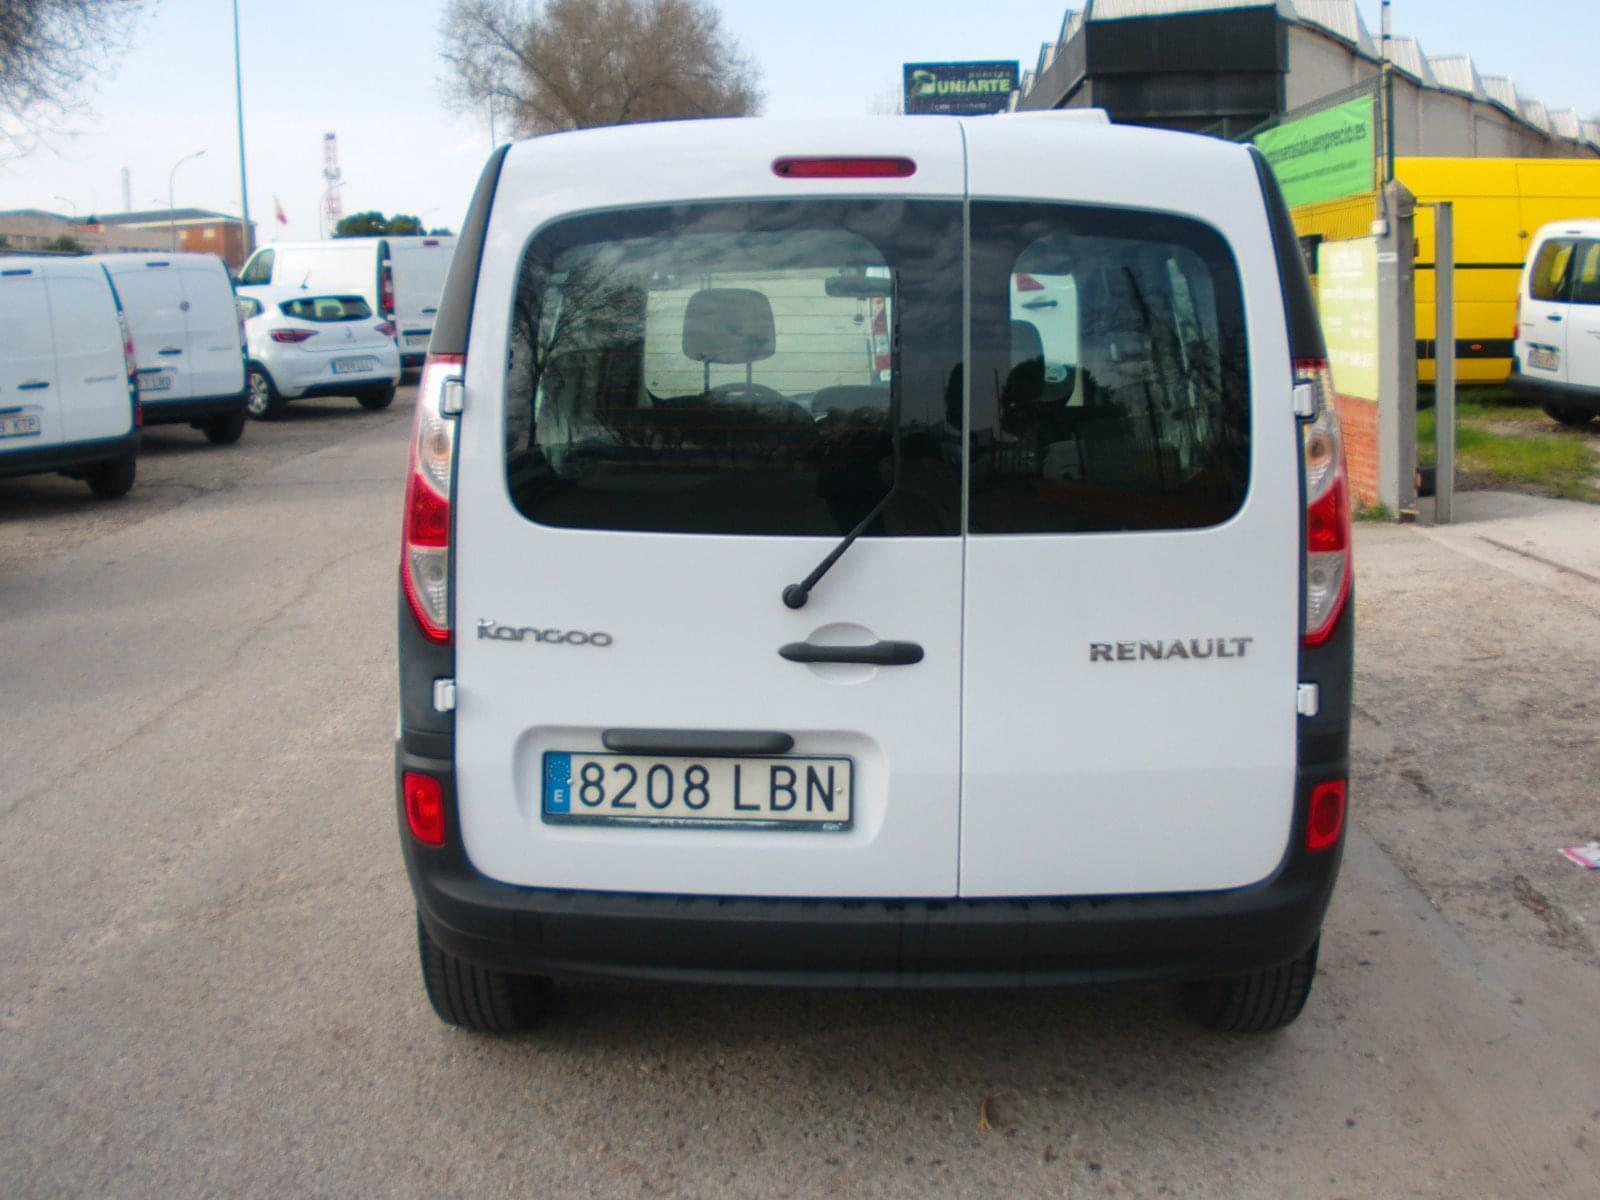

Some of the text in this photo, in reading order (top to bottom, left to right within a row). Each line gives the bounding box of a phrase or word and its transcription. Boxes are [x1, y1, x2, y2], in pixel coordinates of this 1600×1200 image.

[1089, 637, 1253, 662] RENAULT
[554, 761, 834, 812] E 8208 LBN
